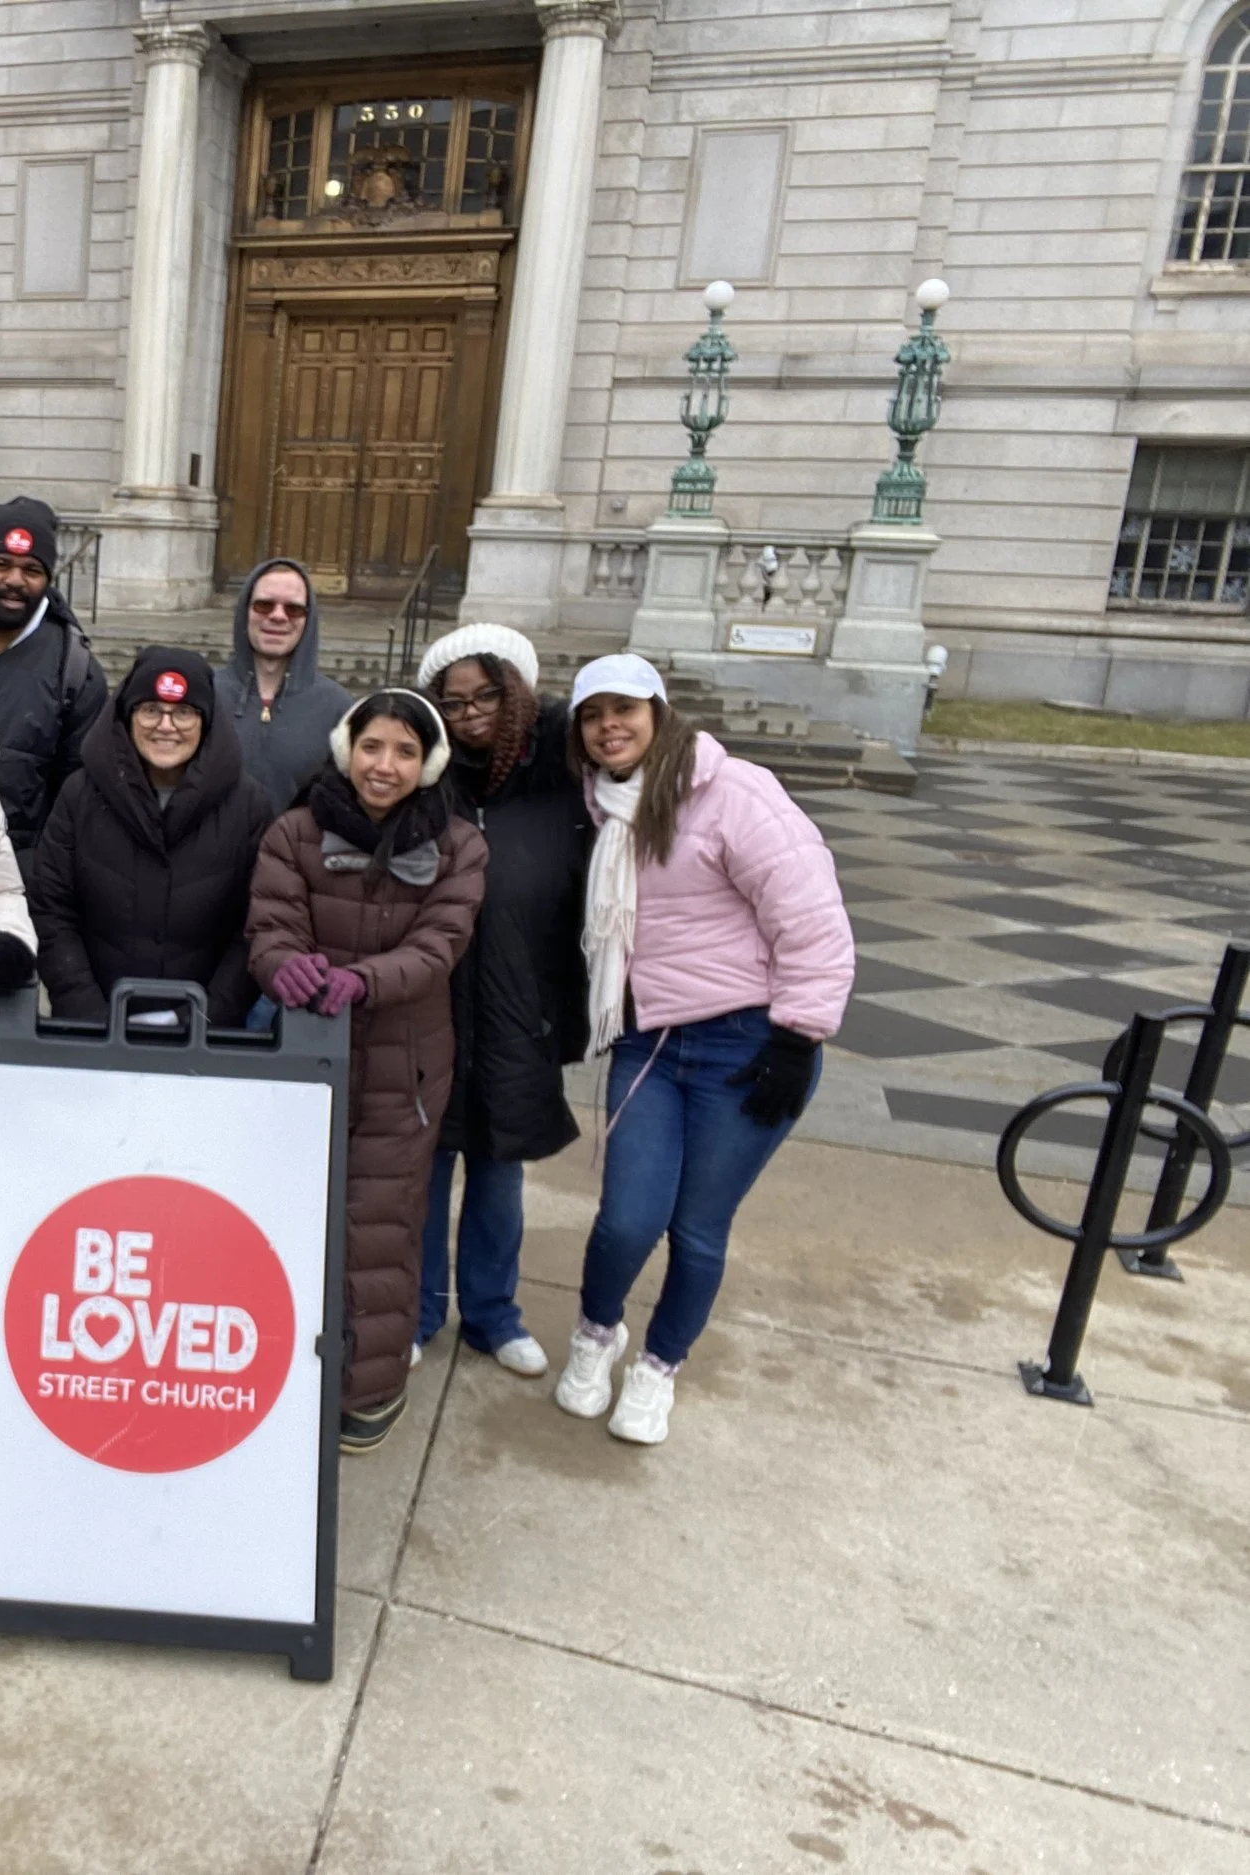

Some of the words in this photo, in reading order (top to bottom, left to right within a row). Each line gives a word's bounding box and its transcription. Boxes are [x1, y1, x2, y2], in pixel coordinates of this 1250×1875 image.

[73, 1227, 153, 1297] BE
[40, 1293, 258, 1374] LOVED
[38, 1372, 135, 1402] STREET
[141, 1380, 255, 1412] CHURCH
